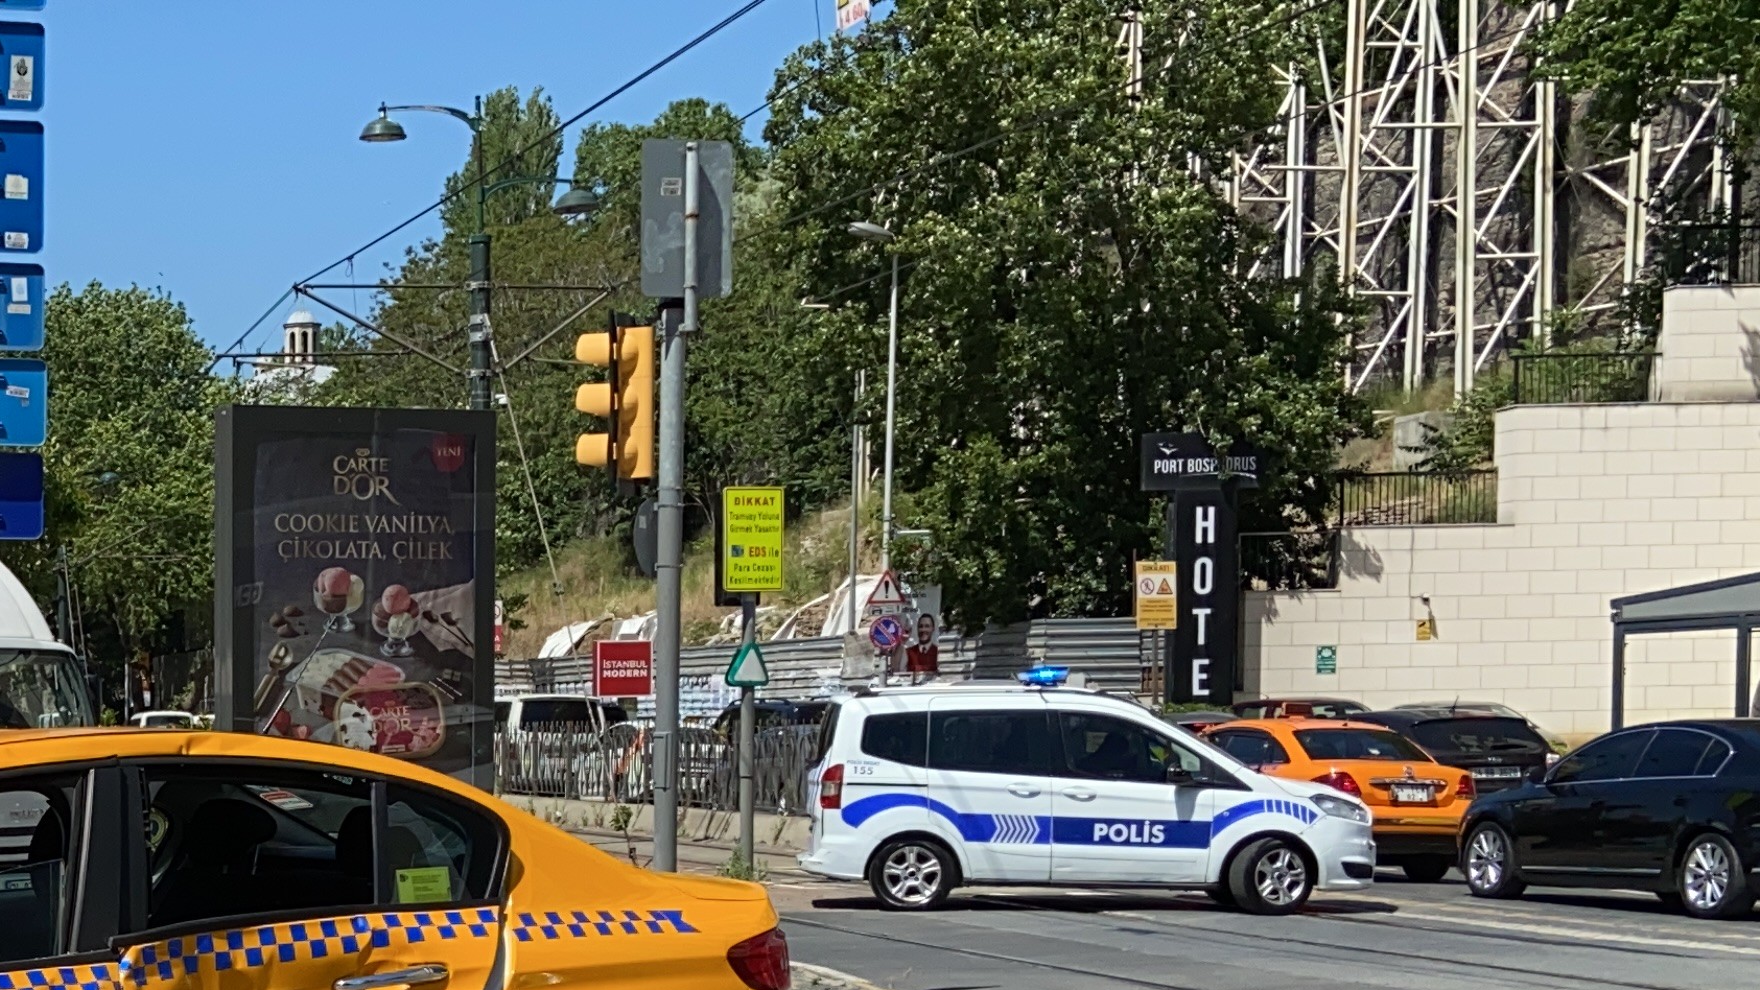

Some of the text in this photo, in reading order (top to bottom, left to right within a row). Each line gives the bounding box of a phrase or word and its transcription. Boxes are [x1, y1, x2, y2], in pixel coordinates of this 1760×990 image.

[333, 456, 389, 474] CARTE
[1154, 456, 1256, 474] PORT BOSPORUS
[334, 473, 402, 506] D'OR
[734, 496, 776, 506] DİKKAT
[274, 511, 455, 535] COOKIE VANİLYA,
[278, 536, 453, 564] ÇİKOLATA, ÇİLEK
[749, 546, 766, 557] EDS
[734, 563, 750, 572] Para
[1192, 506, 1215, 696] HOTE
[603, 659, 648, 668] İSTANBUL
[602, 669, 648, 678] MODERN
[370, 706, 410, 719] CARTE
[854, 766, 873, 775] 155
[1093, 820, 1165, 843] POLİS
